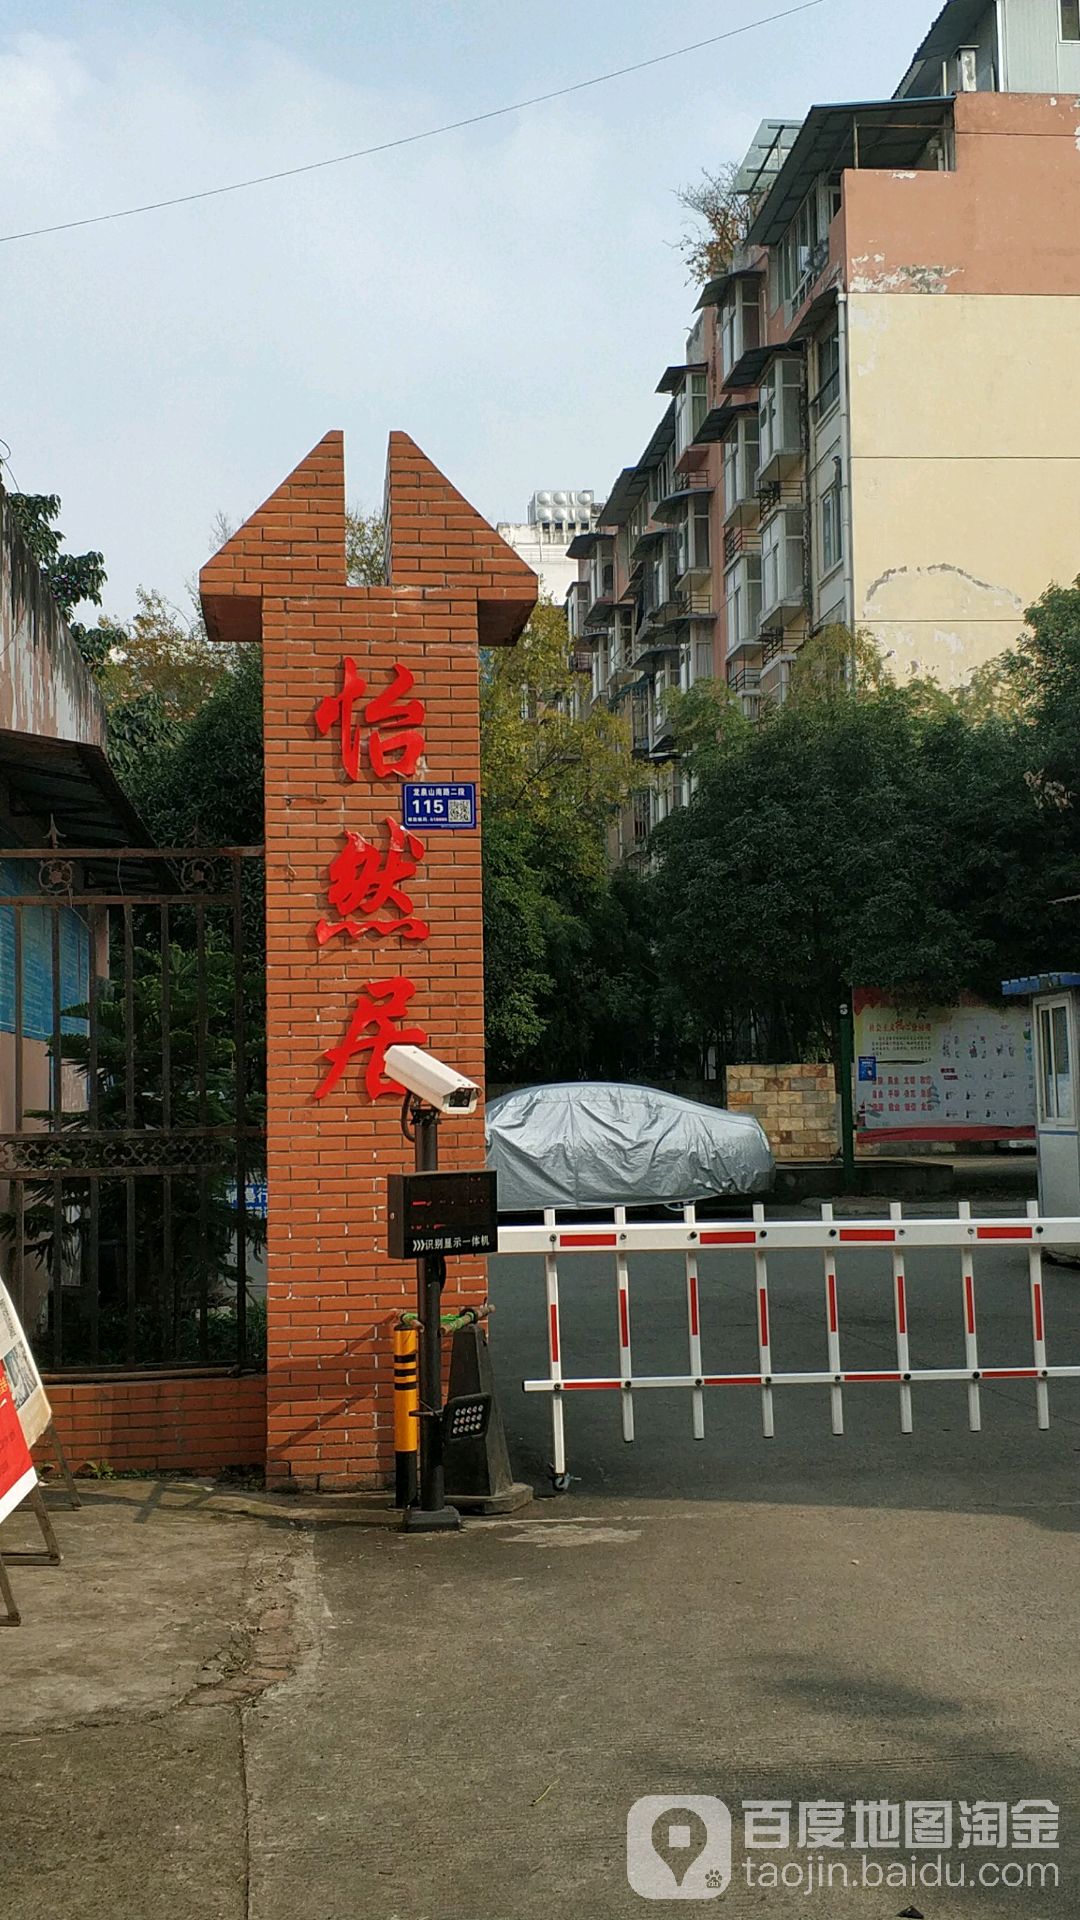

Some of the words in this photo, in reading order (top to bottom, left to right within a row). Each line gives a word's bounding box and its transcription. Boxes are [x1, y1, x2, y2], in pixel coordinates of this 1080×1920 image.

[412, 800, 444, 814] 115
[315, 656, 430, 1101] 怡然居
[424, 1235, 490, 1250] 识别显示一体机
